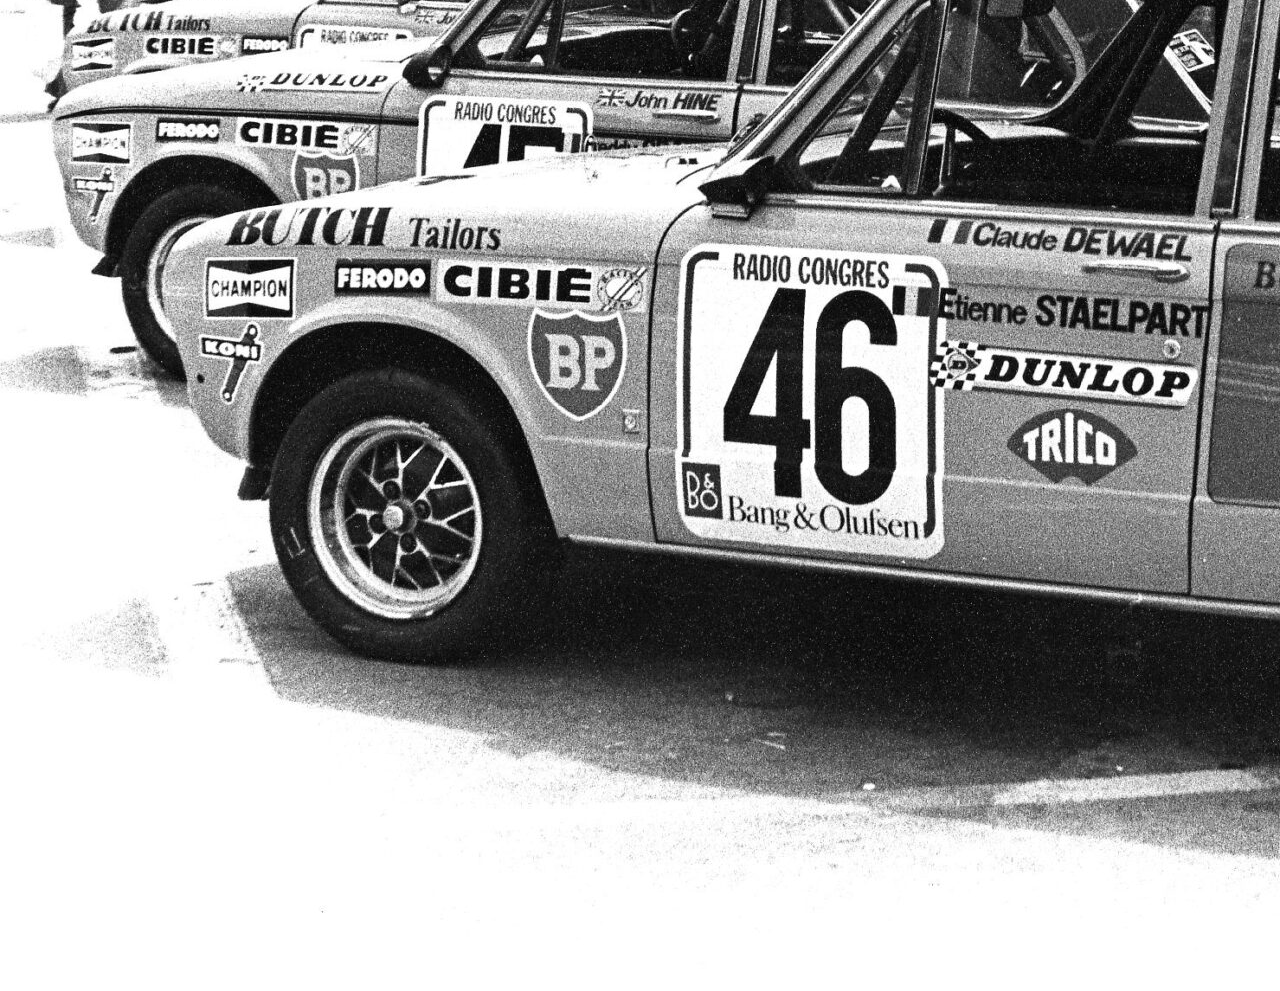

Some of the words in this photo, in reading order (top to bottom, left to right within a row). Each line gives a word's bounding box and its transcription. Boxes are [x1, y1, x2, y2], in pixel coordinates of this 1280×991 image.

[166, 15, 210, 32] Tailors
[269, 72, 389, 88] DUNLOP
[454, 101, 493, 122] RADIO
[497, 104, 556, 125] CONGRES
[625, 90, 669, 110] John
[672, 92, 722, 111] HINE
[157, 122, 219, 139] FERODO
[224, 206, 394, 247] BUTCH
[409, 217, 501, 251] Tailors
[972, 222, 1059, 252] Claude
[1062, 226, 1193, 262] DEWAEL
[337, 266, 426, 290] FERODO
[733, 252, 791, 283] RADIO
[798, 257, 890, 288] CONGRES
[211, 279, 288, 299] CHAMPION
[938, 286, 1027, 326] Etienne
[1035, 295, 1211, 339] STAELPART
[203, 338, 258, 359] KONI
[545, 332, 616, 391] BP
[984, 353, 1191, 399] DUNLOP
[723, 286, 898, 505] 46
[1023, 412, 1117, 466] TRICO
[728, 494, 790, 533] Bang
[793, 501, 819, 531] &
[820, 504, 920, 539] Olufsen
